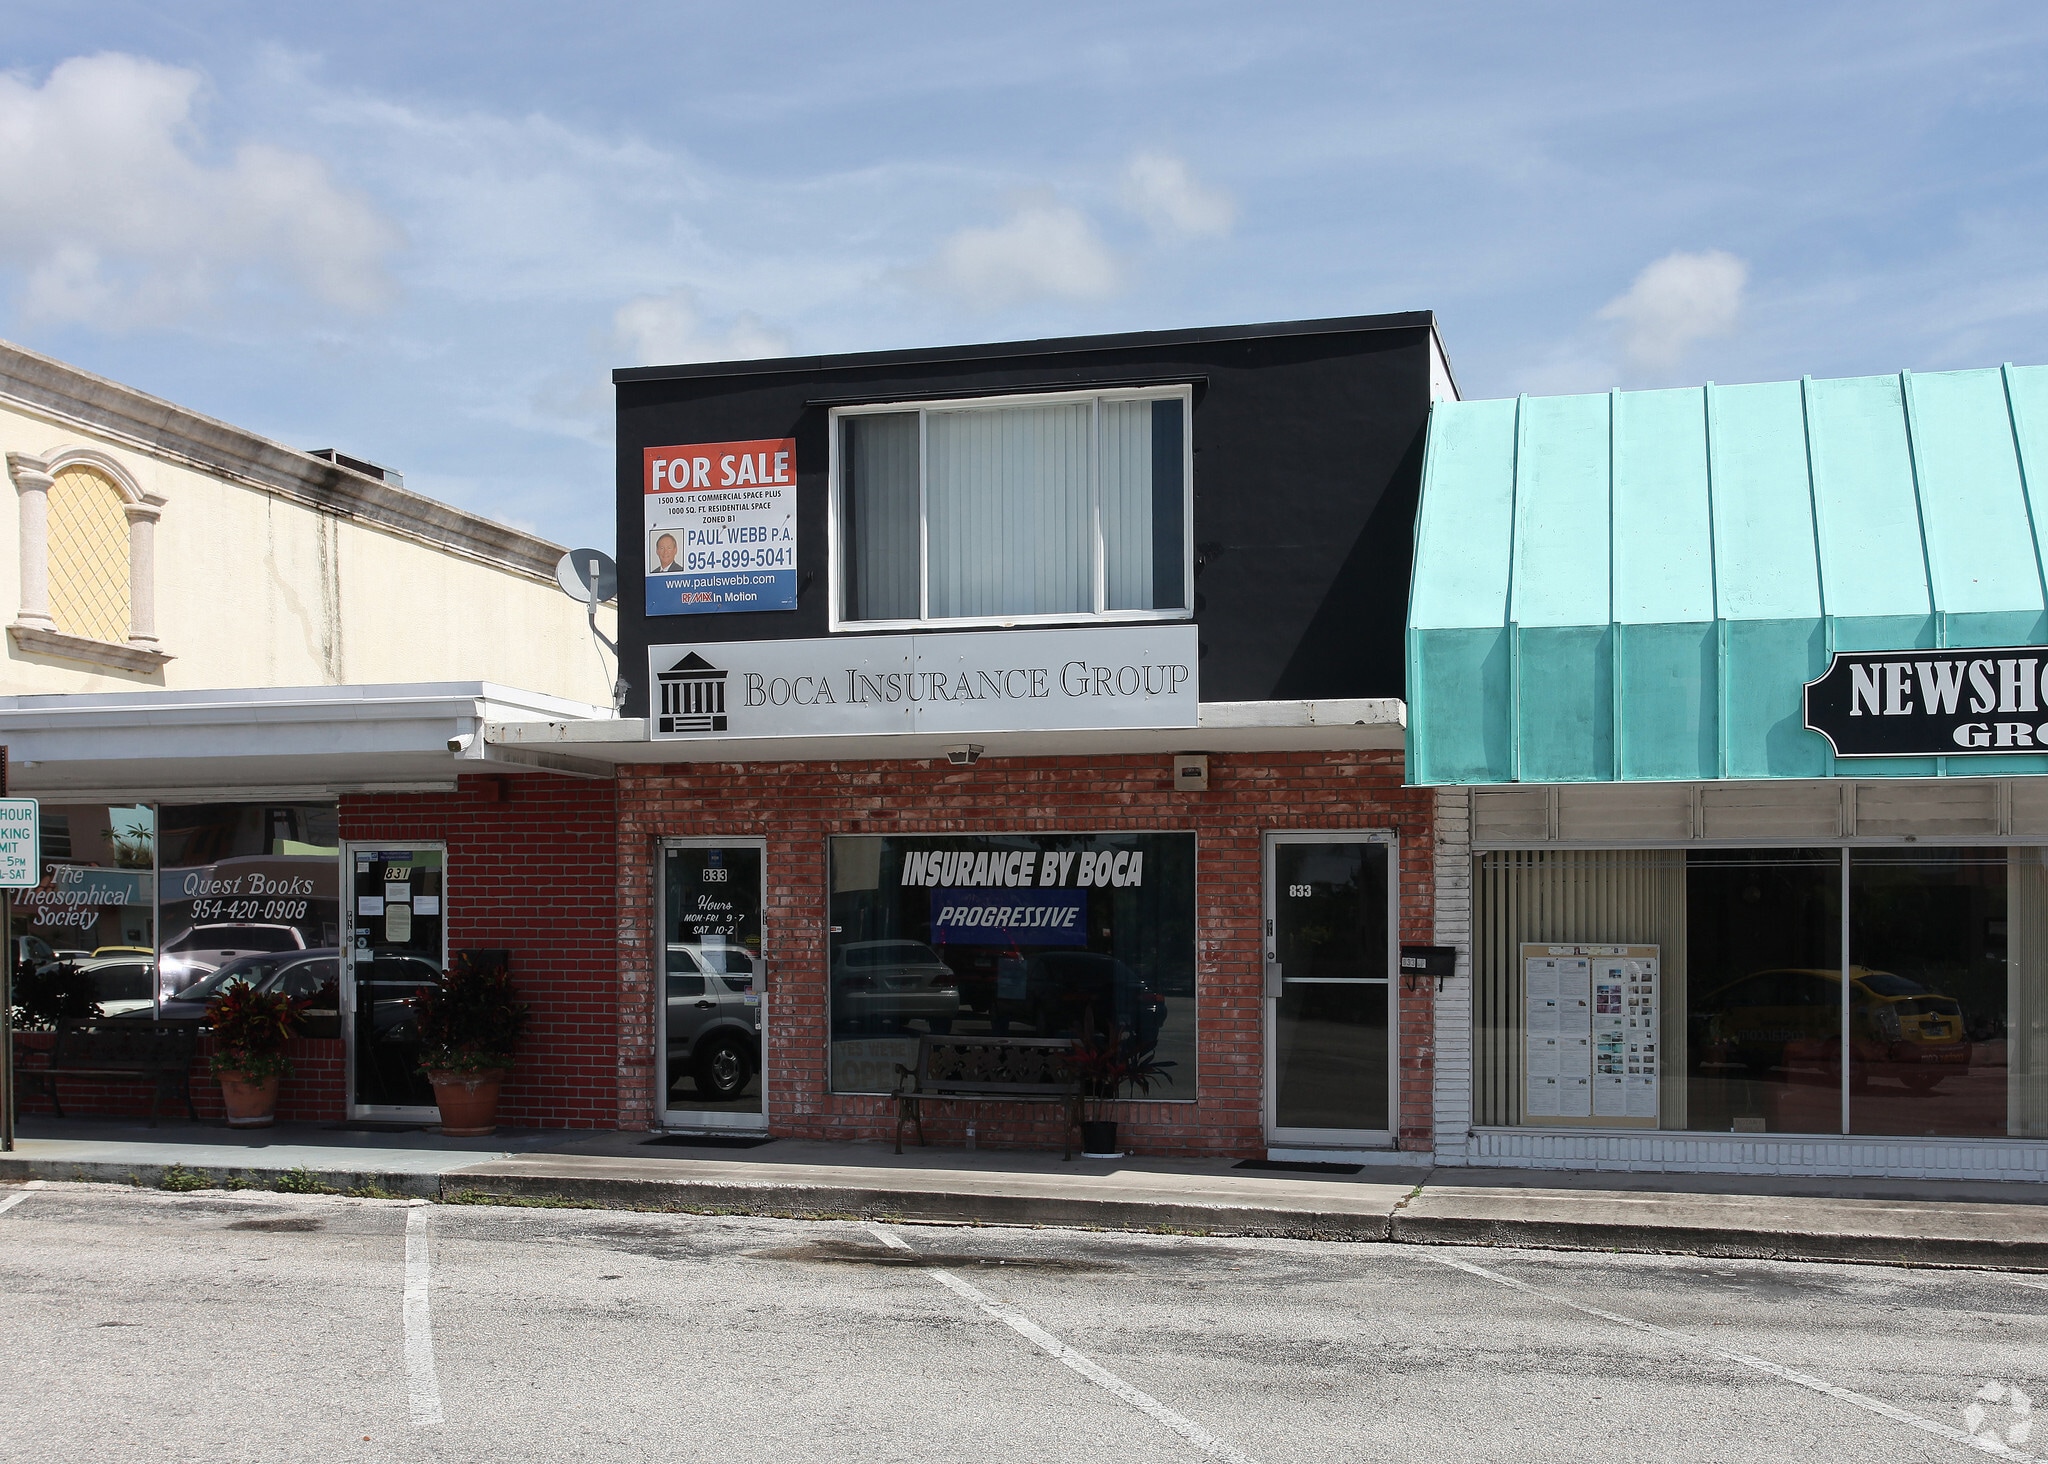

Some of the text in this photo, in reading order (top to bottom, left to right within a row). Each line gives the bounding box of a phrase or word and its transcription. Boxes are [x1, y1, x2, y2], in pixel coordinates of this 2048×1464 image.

[652, 452, 789, 491] FOR SALE
[658, 497, 674, 505] 1500
[675, 496, 686, 504] SQ.
[697, 493, 742, 502] COMMERCIAL
[743, 491, 763, 499] SPACE
[765, 490, 782, 498] PLUS
[668, 507, 684, 515] 1000
[685, 506, 697, 514] SQ.
[708, 503, 750, 513] RESIDENTIAL
[751, 502, 771, 510] SPACE
[702, 515, 736, 524] ZONED B1
[688, 526, 794, 546] PAUL WEBB P.A.
[687, 547, 793, 571] 954-899-5041
[666, 574, 775, 590] www.paulswebb.com
[713, 593, 722, 603] In
[725, 592, 758, 602] Motion
[743, 661, 1189, 707] BOCA INSURANCE GROUP
[1849, 659, 2048, 716] NEWSH
[0, 808, 32, 821] HOUR
[46, 864, 84, 884] The
[386, 868, 409, 879] 831
[704, 870, 726, 881] 833
[901, 851, 1144, 887] INSURANCE BY BOCA
[183, 872, 314, 897] Quest Books
[1289, 884, 1312, 898] 833
[10, 884, 132, 910] Theosophical
[697, 894, 733, 911] Hours
[33, 906, 100, 930] Society
[190, 899, 308, 919] 954-420-0908
[936, 906, 1080, 928] PROGRESSIVE
[692, 926, 735, 935] SAT 10-2
[840, 1042, 863, 1056] YES
